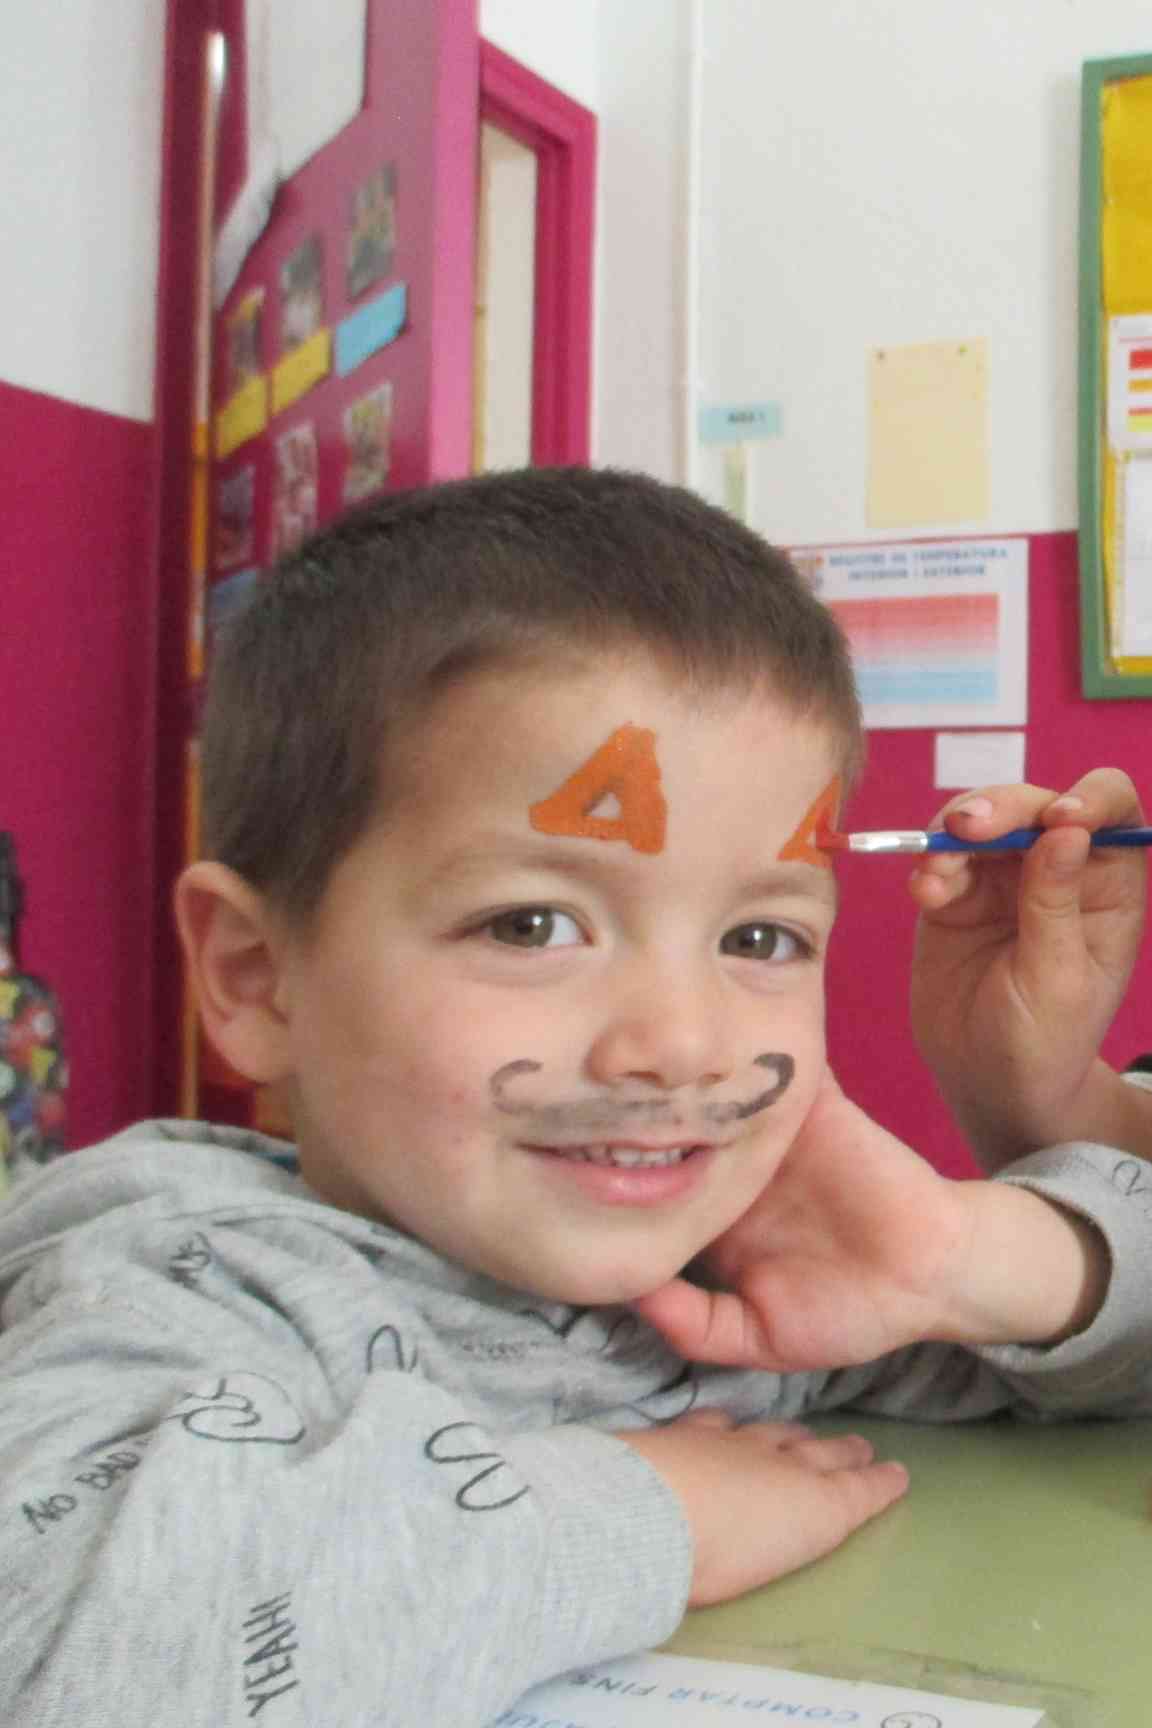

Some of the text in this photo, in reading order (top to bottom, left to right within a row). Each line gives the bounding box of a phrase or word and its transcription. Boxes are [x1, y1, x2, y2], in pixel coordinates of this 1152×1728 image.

[22, 1451, 142, 1535] NO BAD
[667, 1686, 862, 1724] COMPTAR
